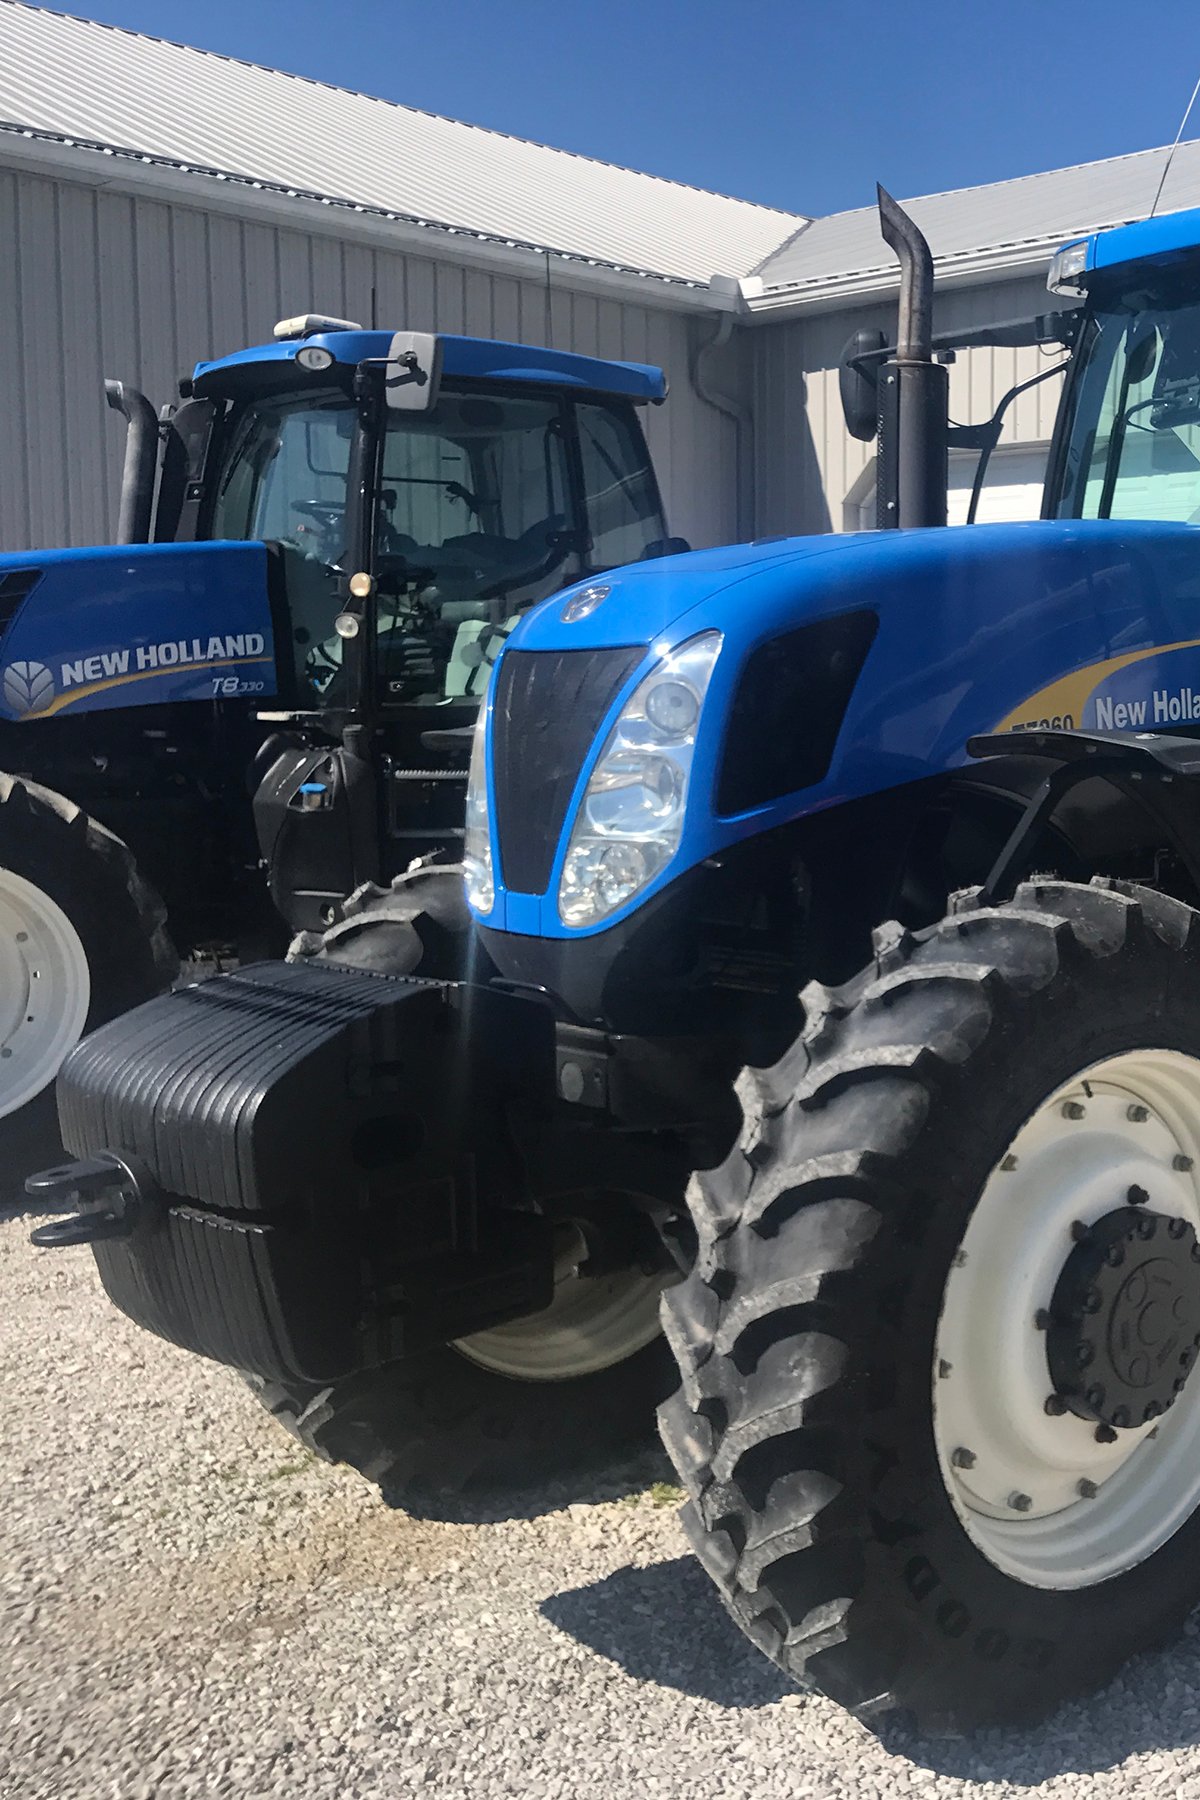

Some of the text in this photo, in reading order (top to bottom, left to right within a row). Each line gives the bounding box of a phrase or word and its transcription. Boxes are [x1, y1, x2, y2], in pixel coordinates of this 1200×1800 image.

[61, 633, 264, 686] NEW HOLLAND
[1095, 696, 1147, 730] New
